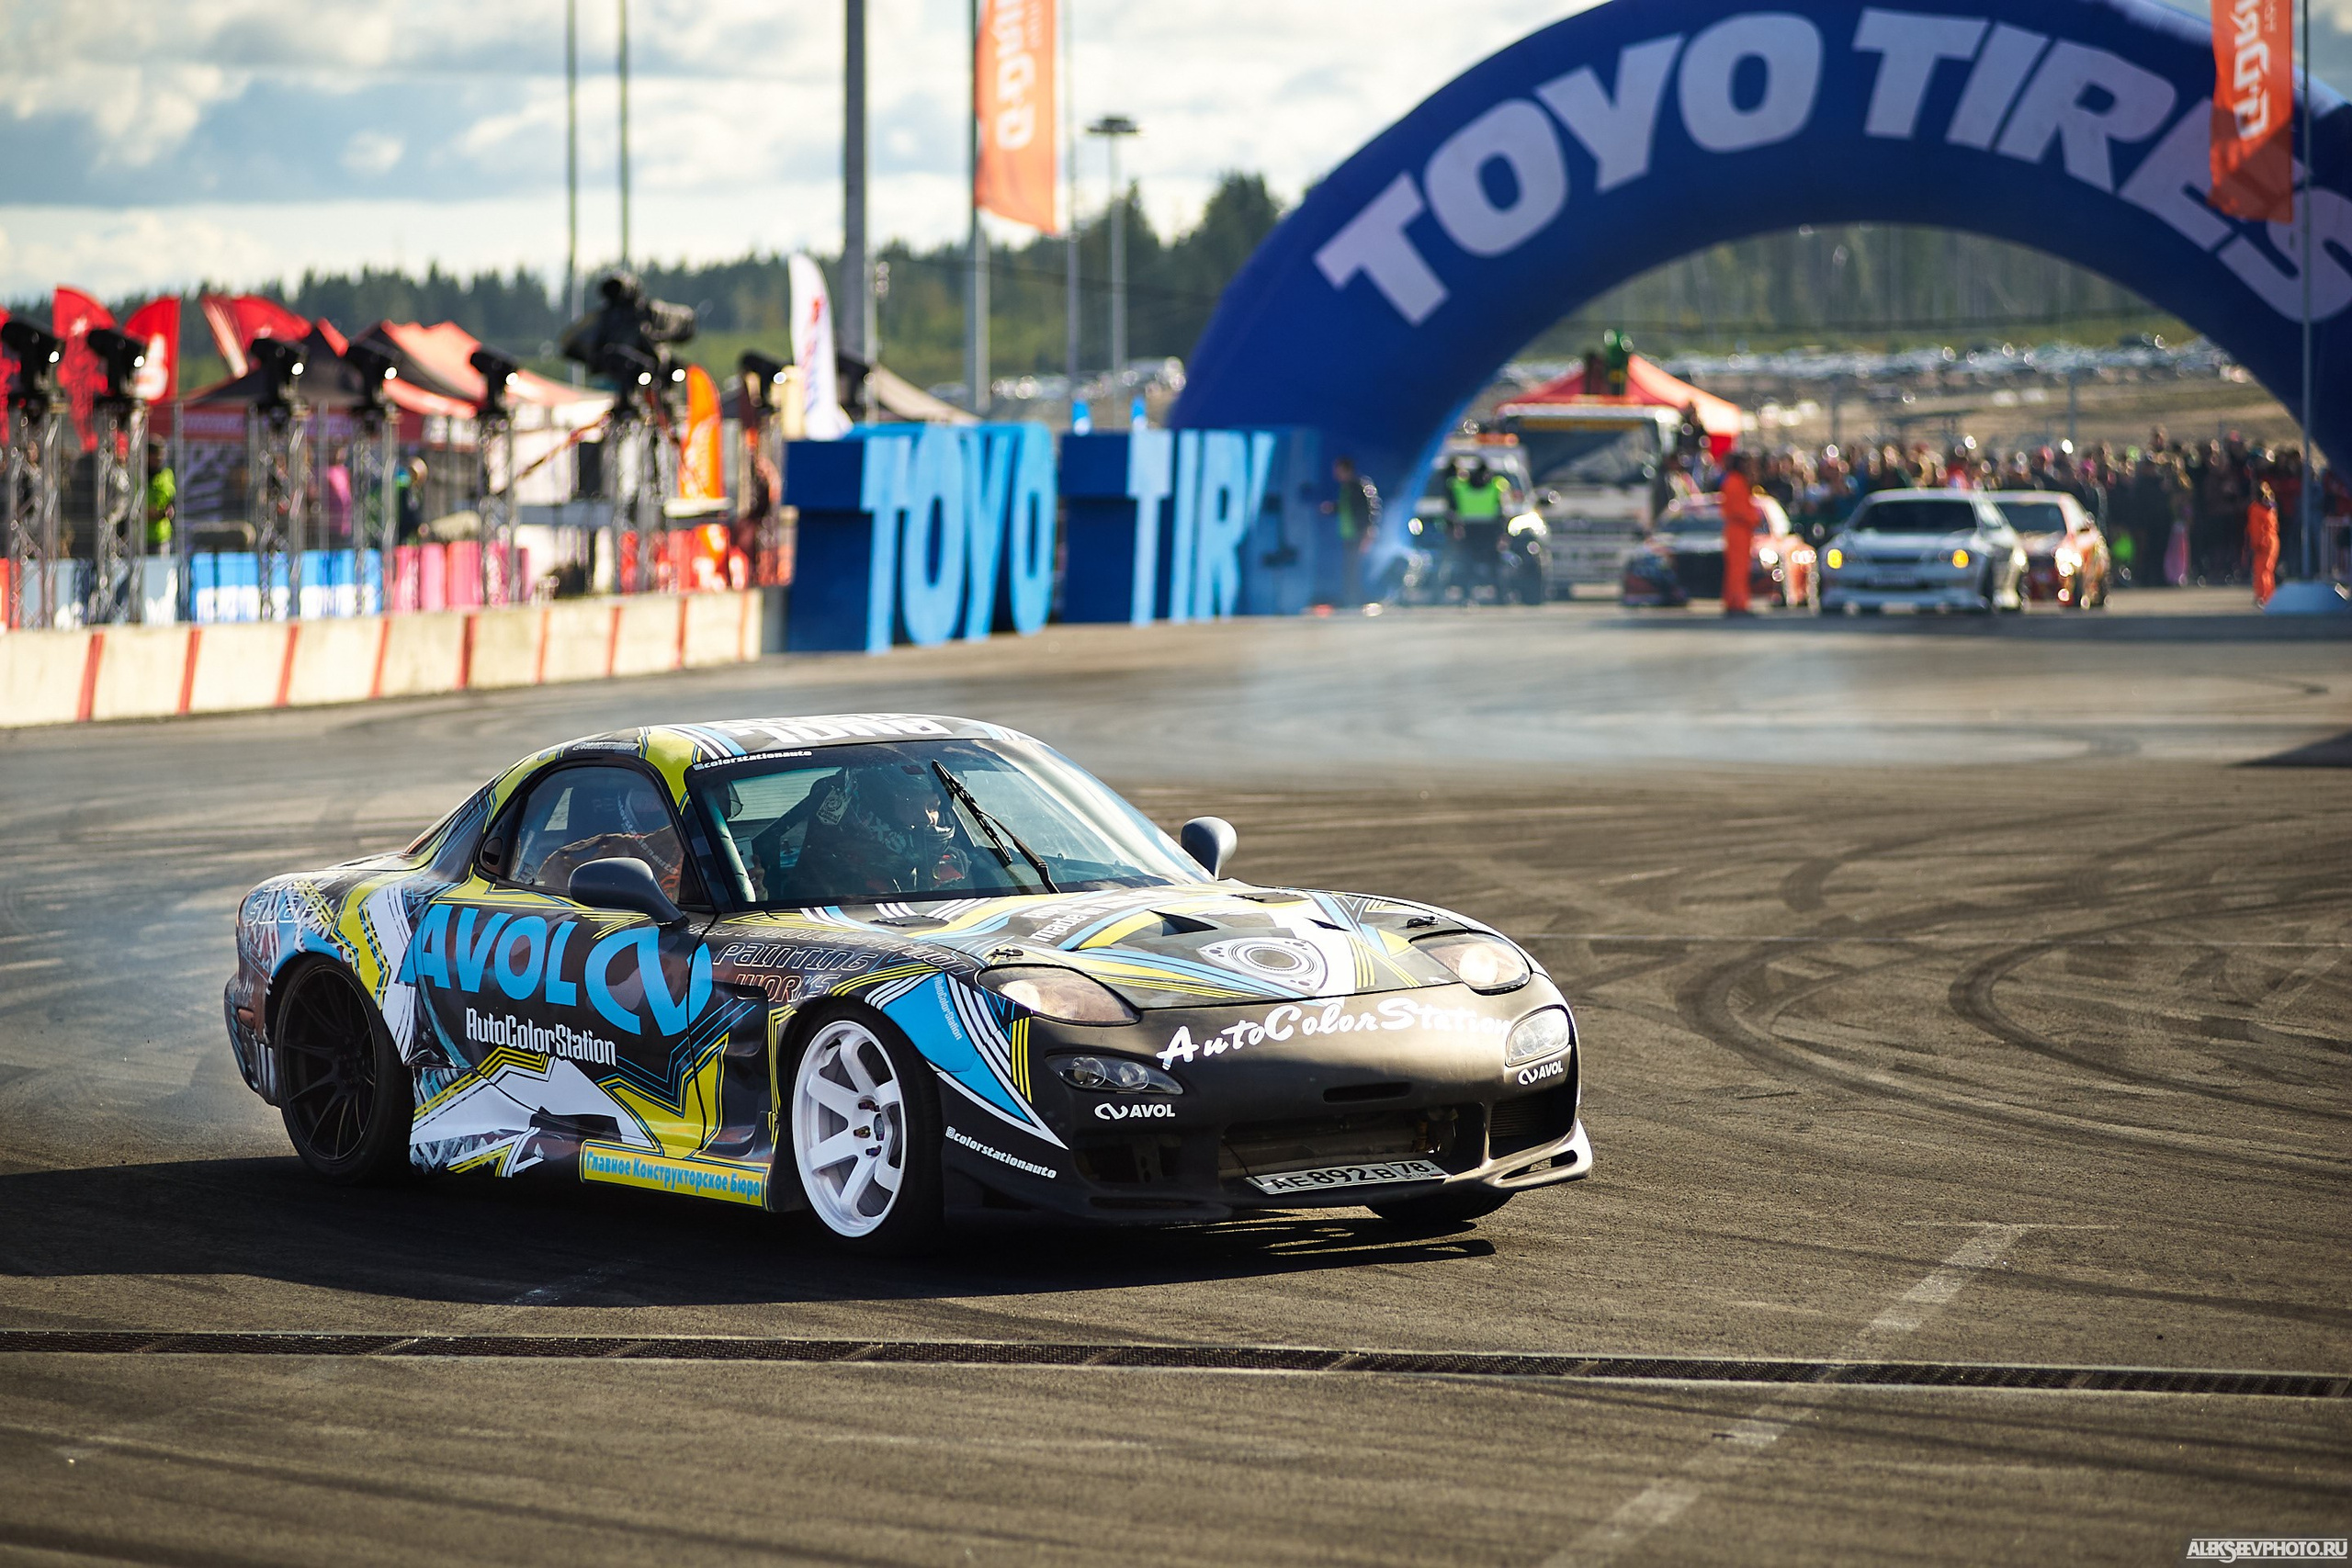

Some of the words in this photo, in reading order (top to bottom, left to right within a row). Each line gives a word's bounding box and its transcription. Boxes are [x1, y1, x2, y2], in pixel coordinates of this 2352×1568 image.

[1314, 13, 1822, 326] TOYO
[861, 424, 1057, 655] TOYO
[395, 904, 578, 1007] AVOL
[466, 1007, 616, 1066] AutoColorStation
[1538, 1060, 1564, 1081] AVOL
[1129, 1104, 1176, 1119] AVOL
[586, 1151, 630, 1176] Главное
[633, 1157, 728, 1193] Конструкторское
[729, 1173, 761, 1201] Бюро
